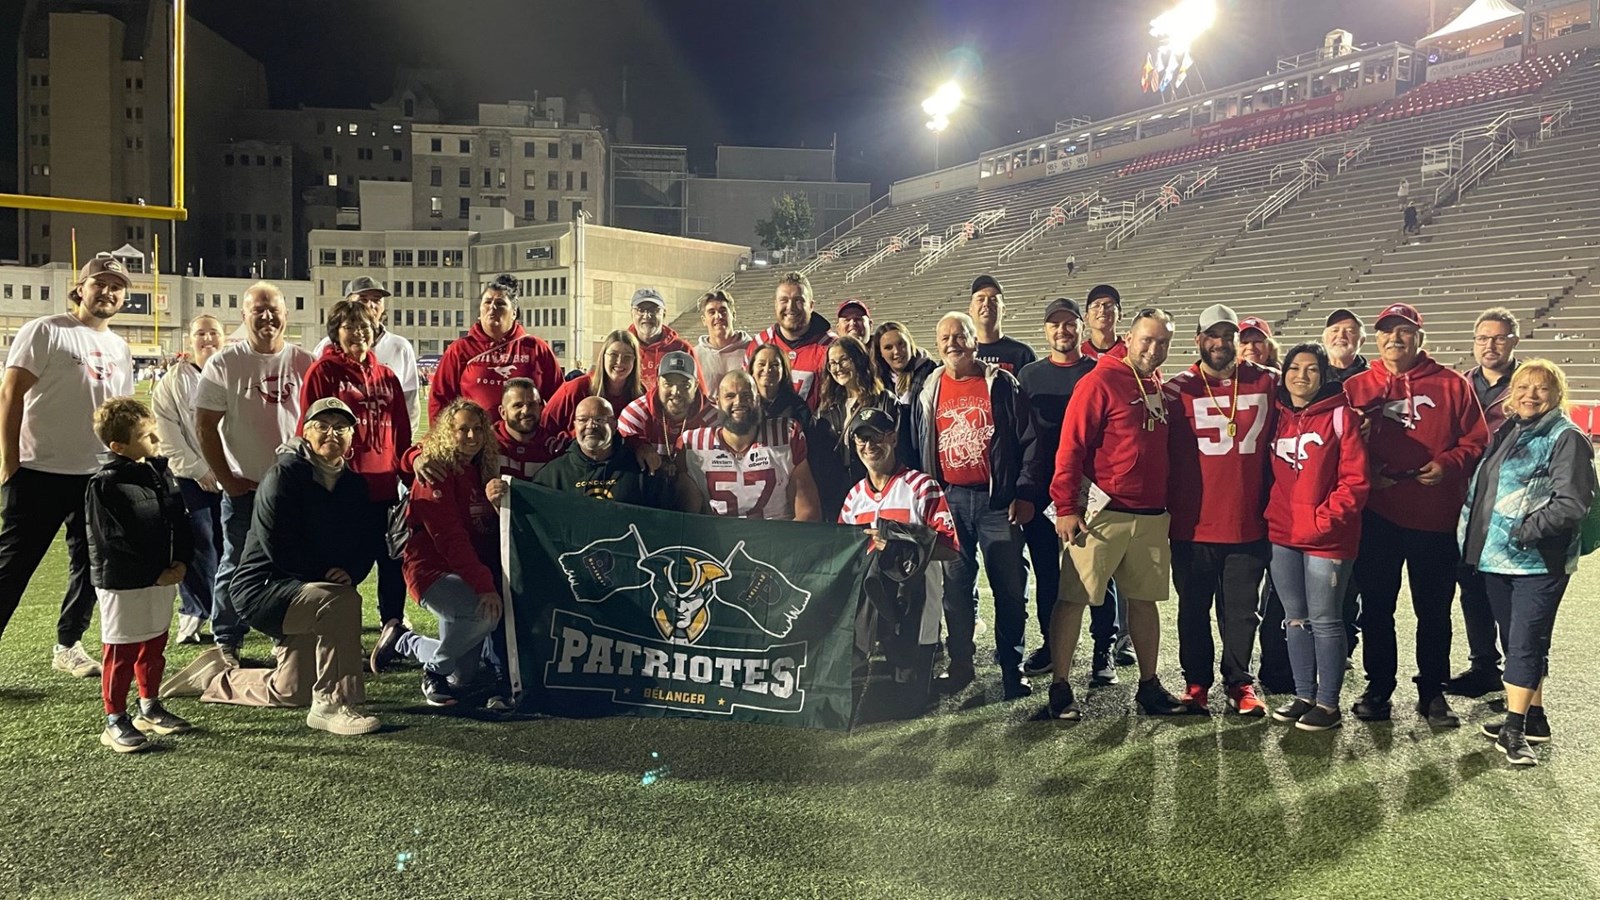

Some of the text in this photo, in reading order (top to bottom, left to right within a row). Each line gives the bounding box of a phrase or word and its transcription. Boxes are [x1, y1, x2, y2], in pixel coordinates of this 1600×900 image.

[1193, 393, 1268, 455] 57
[705, 467, 777, 518] 57
[557, 626, 795, 699] PATRIOTES
[643, 686, 706, 704] BÉLANGER
